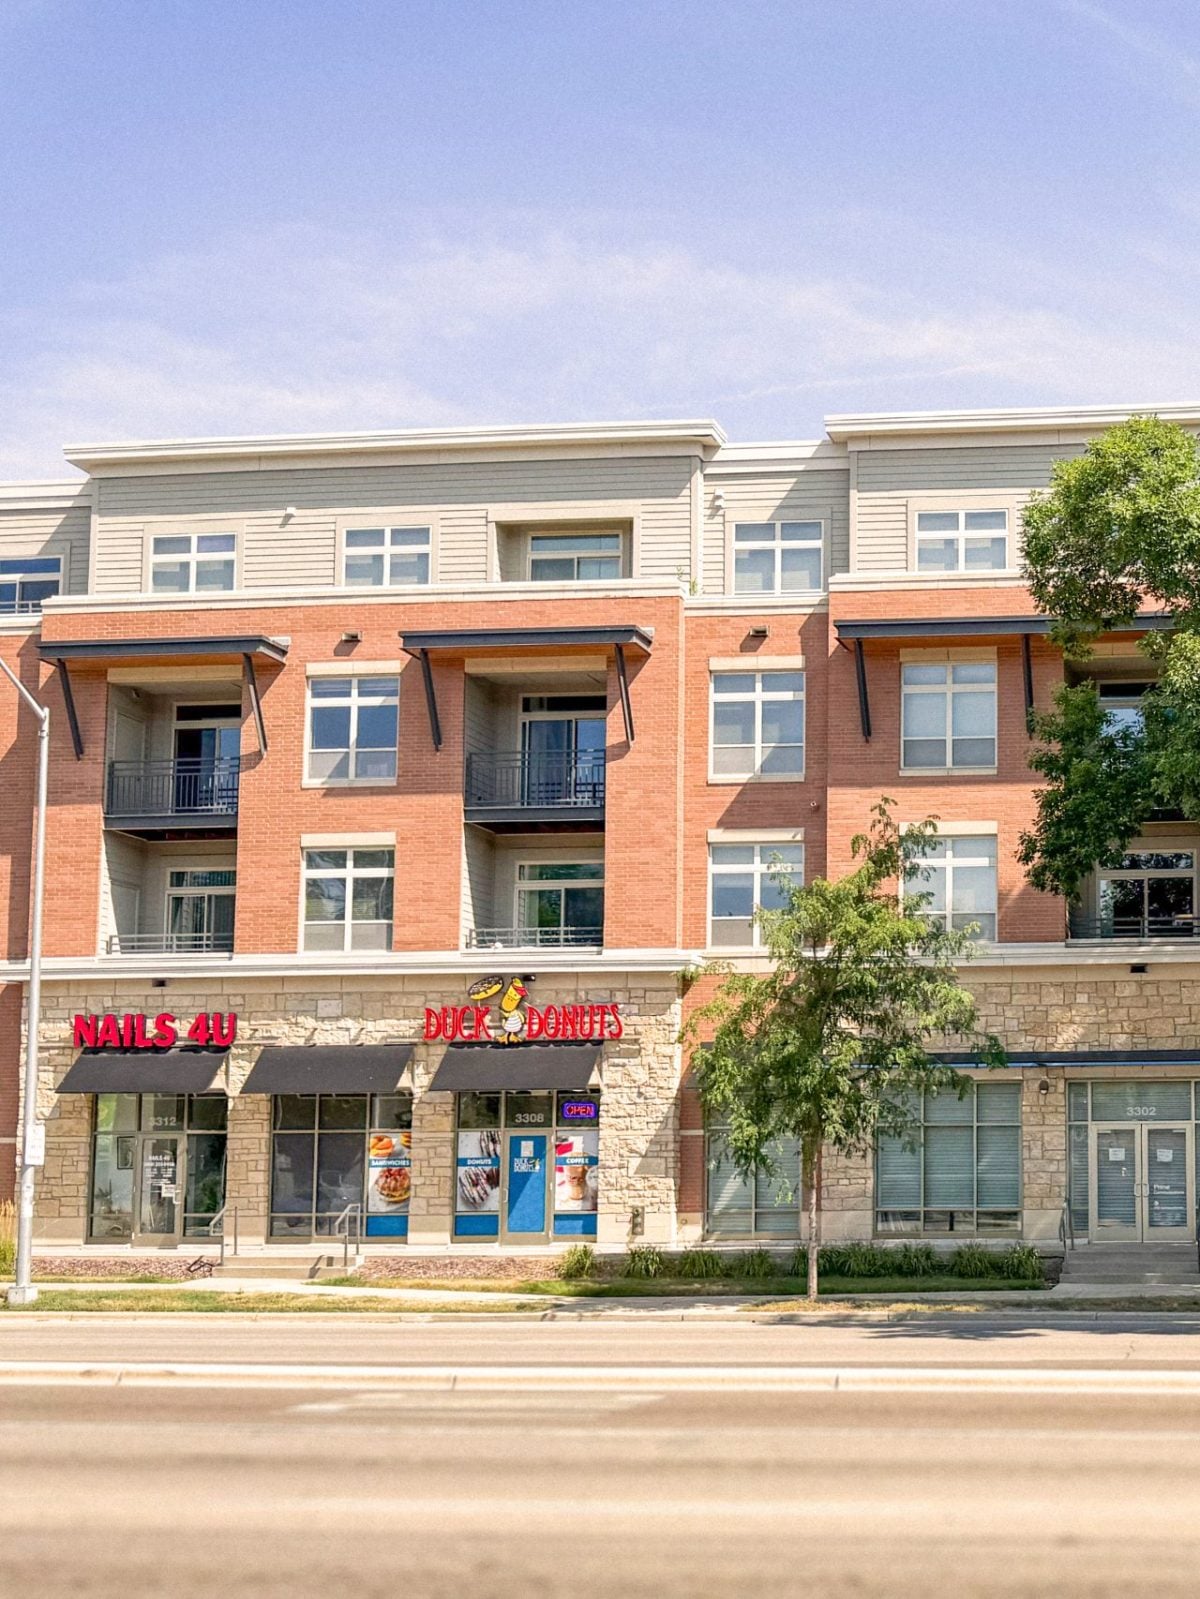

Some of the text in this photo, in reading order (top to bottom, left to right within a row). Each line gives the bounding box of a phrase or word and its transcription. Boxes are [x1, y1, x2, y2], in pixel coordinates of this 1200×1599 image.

[424, 1003, 625, 1041] DUCK DONUTS
[74, 1012, 237, 1047] NAILS 4U
[565, 1104, 594, 1116] OPEN
[1126, 1106, 1157, 1116] 3302
[148, 1116, 177, 1127] 3312
[515, 1113, 545, 1124] 3308
